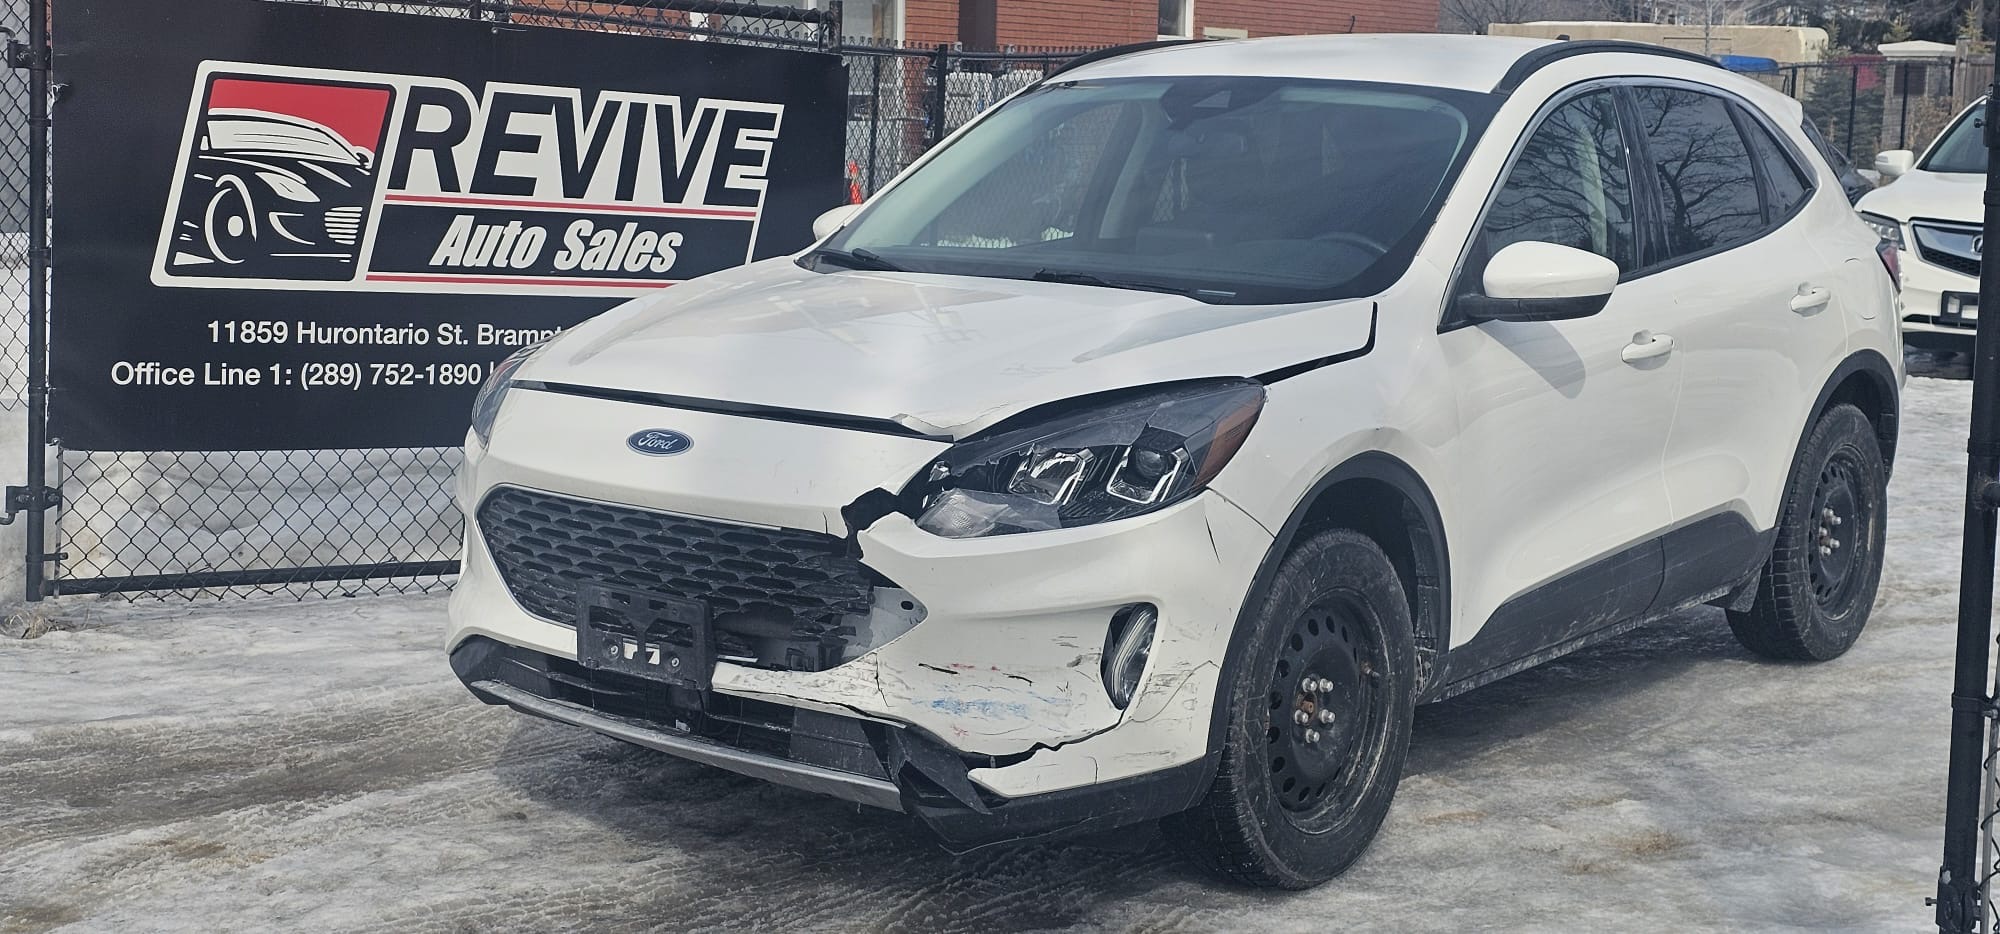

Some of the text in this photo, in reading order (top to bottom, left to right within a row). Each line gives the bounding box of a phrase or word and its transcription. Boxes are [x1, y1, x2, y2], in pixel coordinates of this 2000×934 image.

[387, 84, 780, 208] REVIVE
[429, 214, 684, 274] Auto Sales
[207, 320, 562, 346] 11859 Hurontario St. Bram
[111, 361, 482, 390] Office Line 1: (289) 752-1890
[637, 431, 679, 450] Ford
